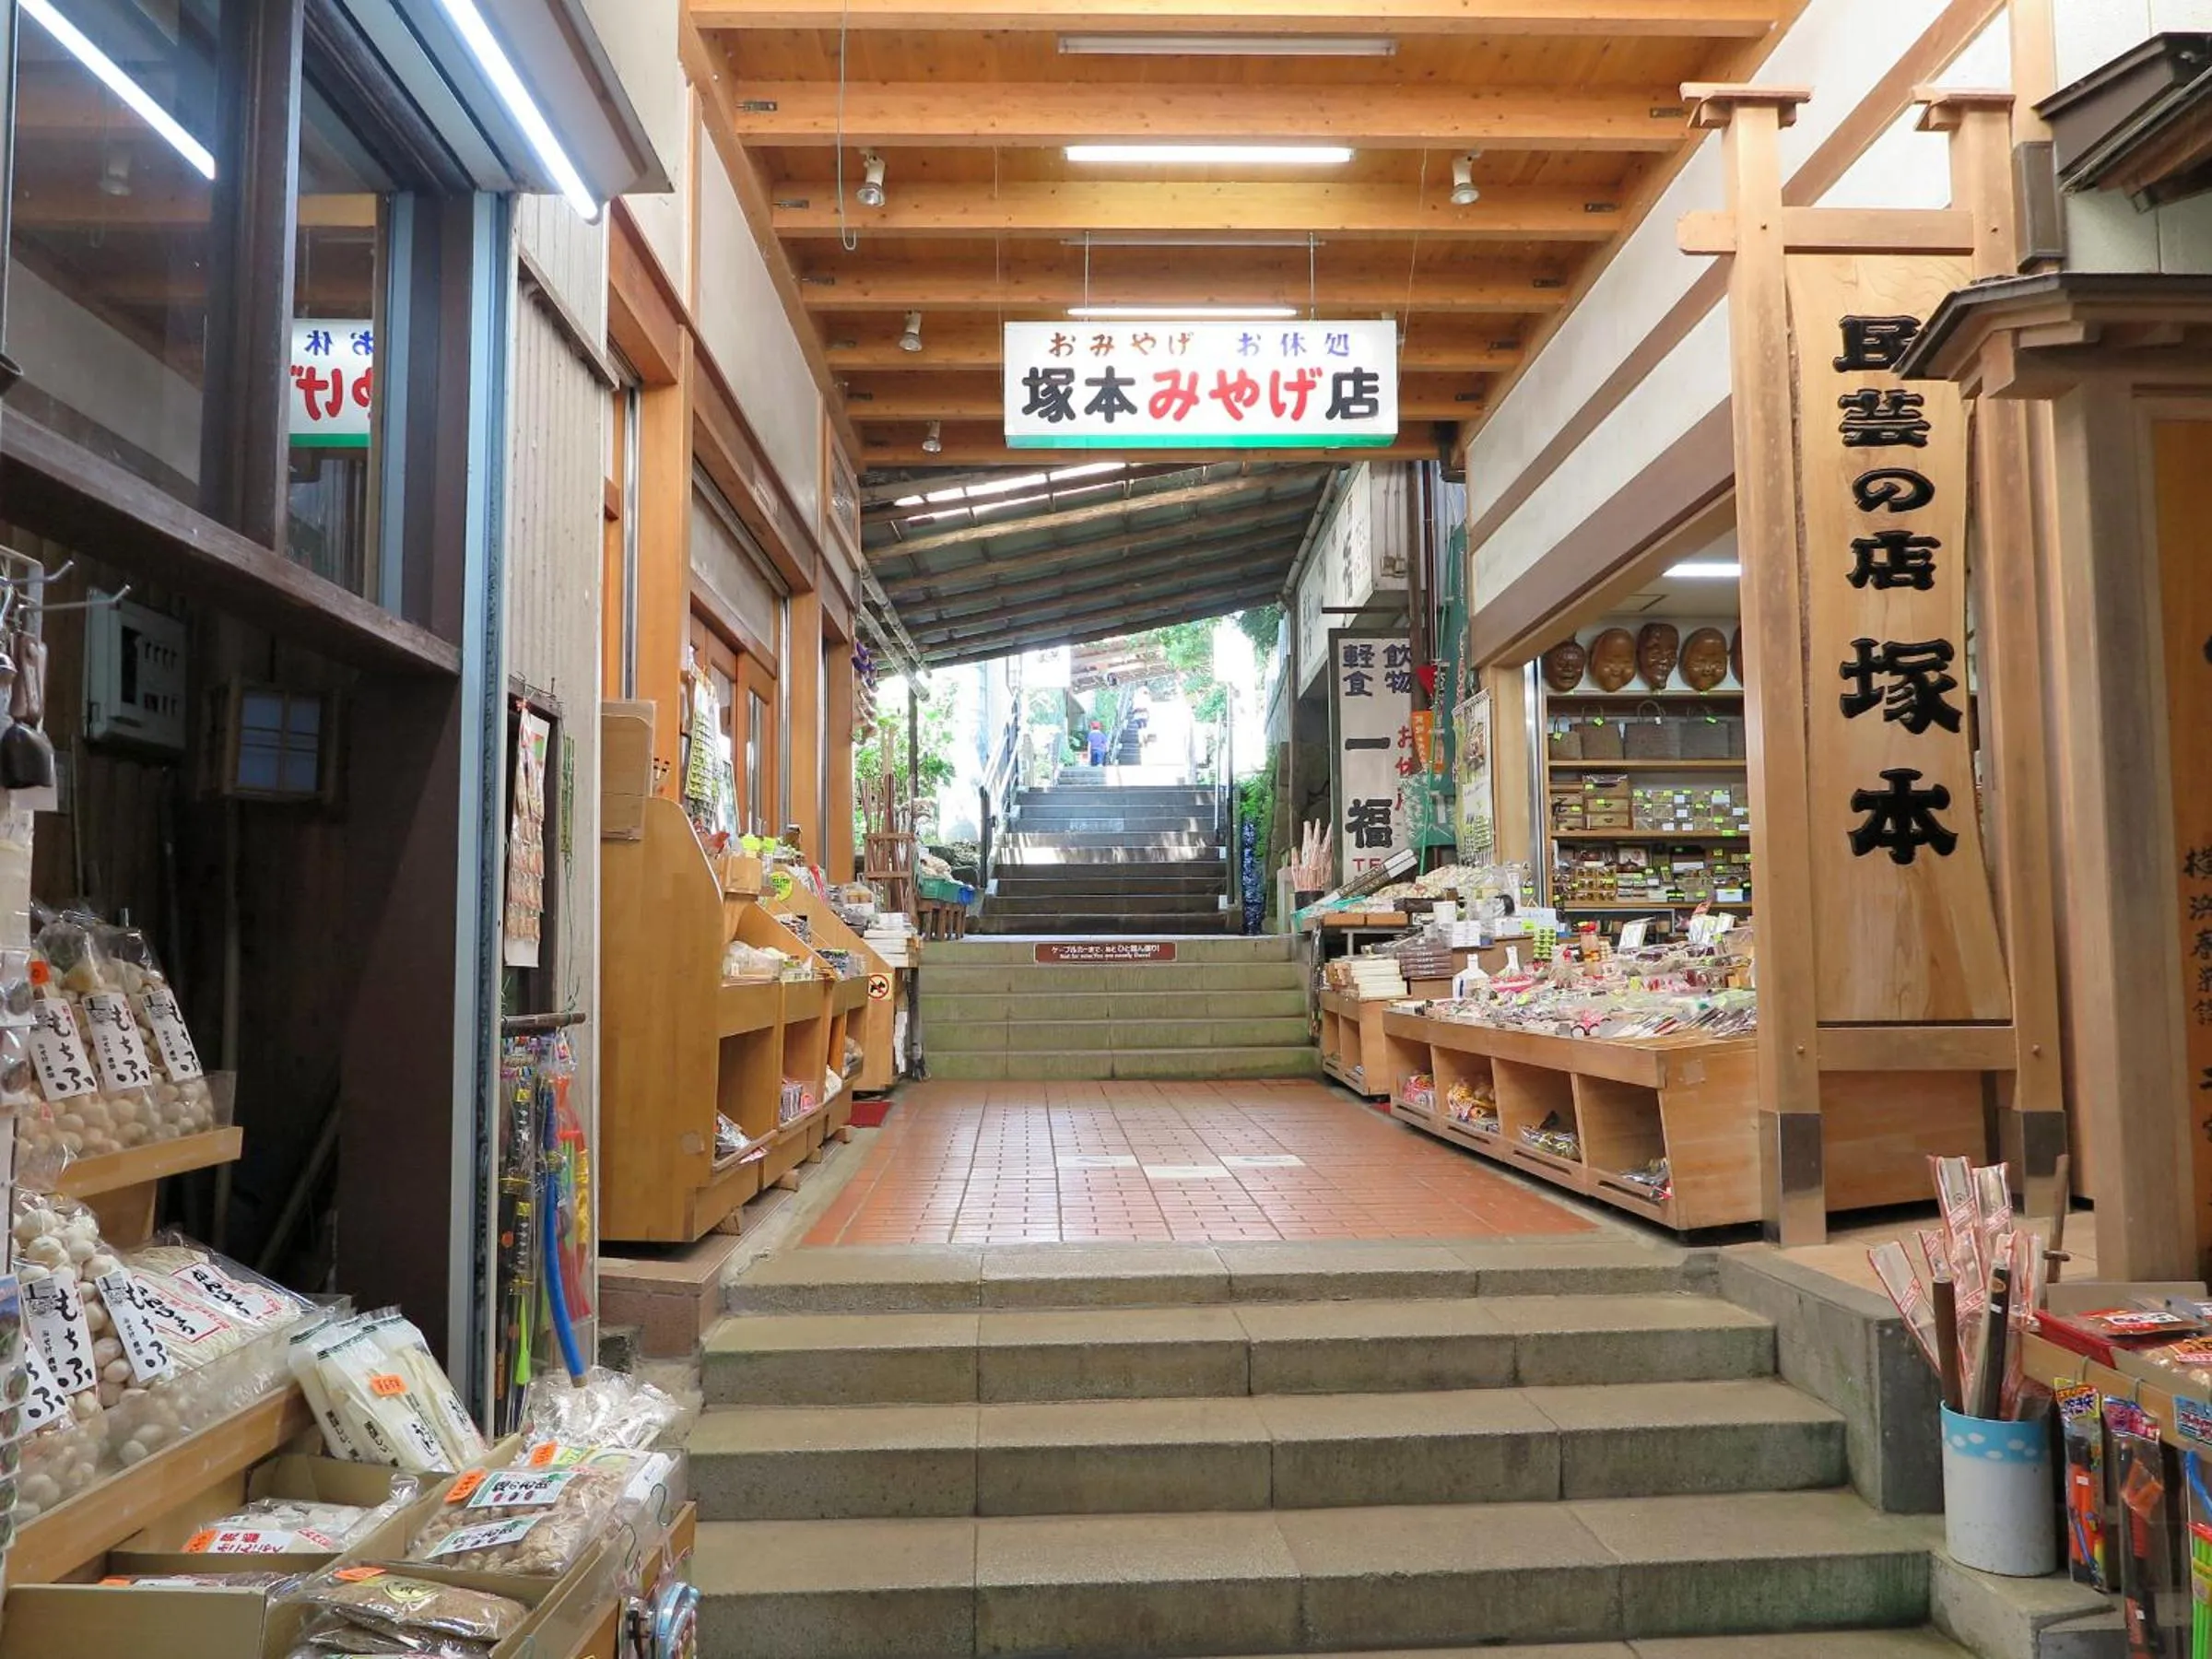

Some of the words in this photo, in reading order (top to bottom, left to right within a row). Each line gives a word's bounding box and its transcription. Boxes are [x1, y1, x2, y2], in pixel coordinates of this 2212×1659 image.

[1049, 332, 1193, 357] おみやげ
[1238, 332, 1350, 357] お休処
[1022, 366, 1380, 423] 塚本みやげ店
[1343, 644, 1375, 696] 軽食
[1382, 644, 1412, 694] 飲物
[1345, 737, 1393, 848] 一福
[1394, 725, 1413, 811] お休
[53, 1288, 93, 1387] もちふ
